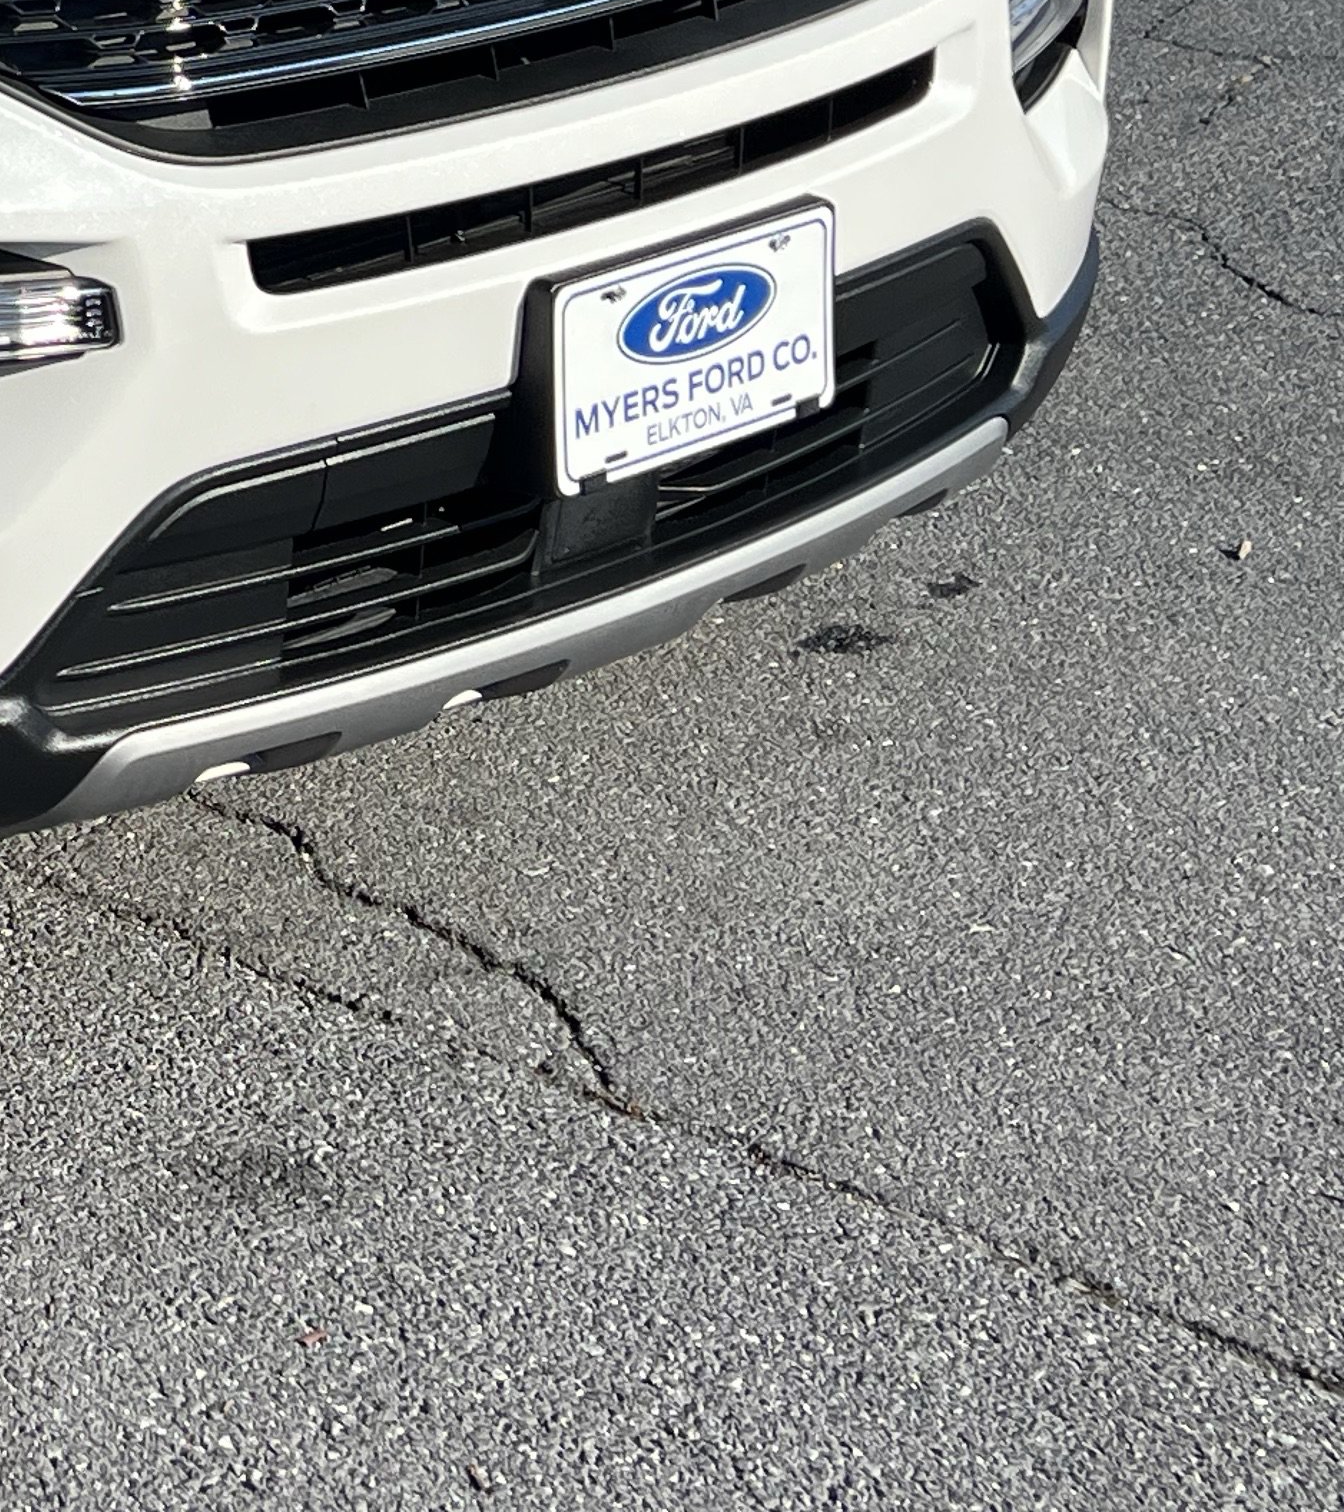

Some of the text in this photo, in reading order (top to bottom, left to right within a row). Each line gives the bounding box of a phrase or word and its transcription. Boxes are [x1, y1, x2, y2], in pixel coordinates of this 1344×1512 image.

[648, 278, 747, 353] Ford
[574, 333, 818, 439] MYERS FORD CO.
[646, 391, 754, 446] ELKTON, VA
